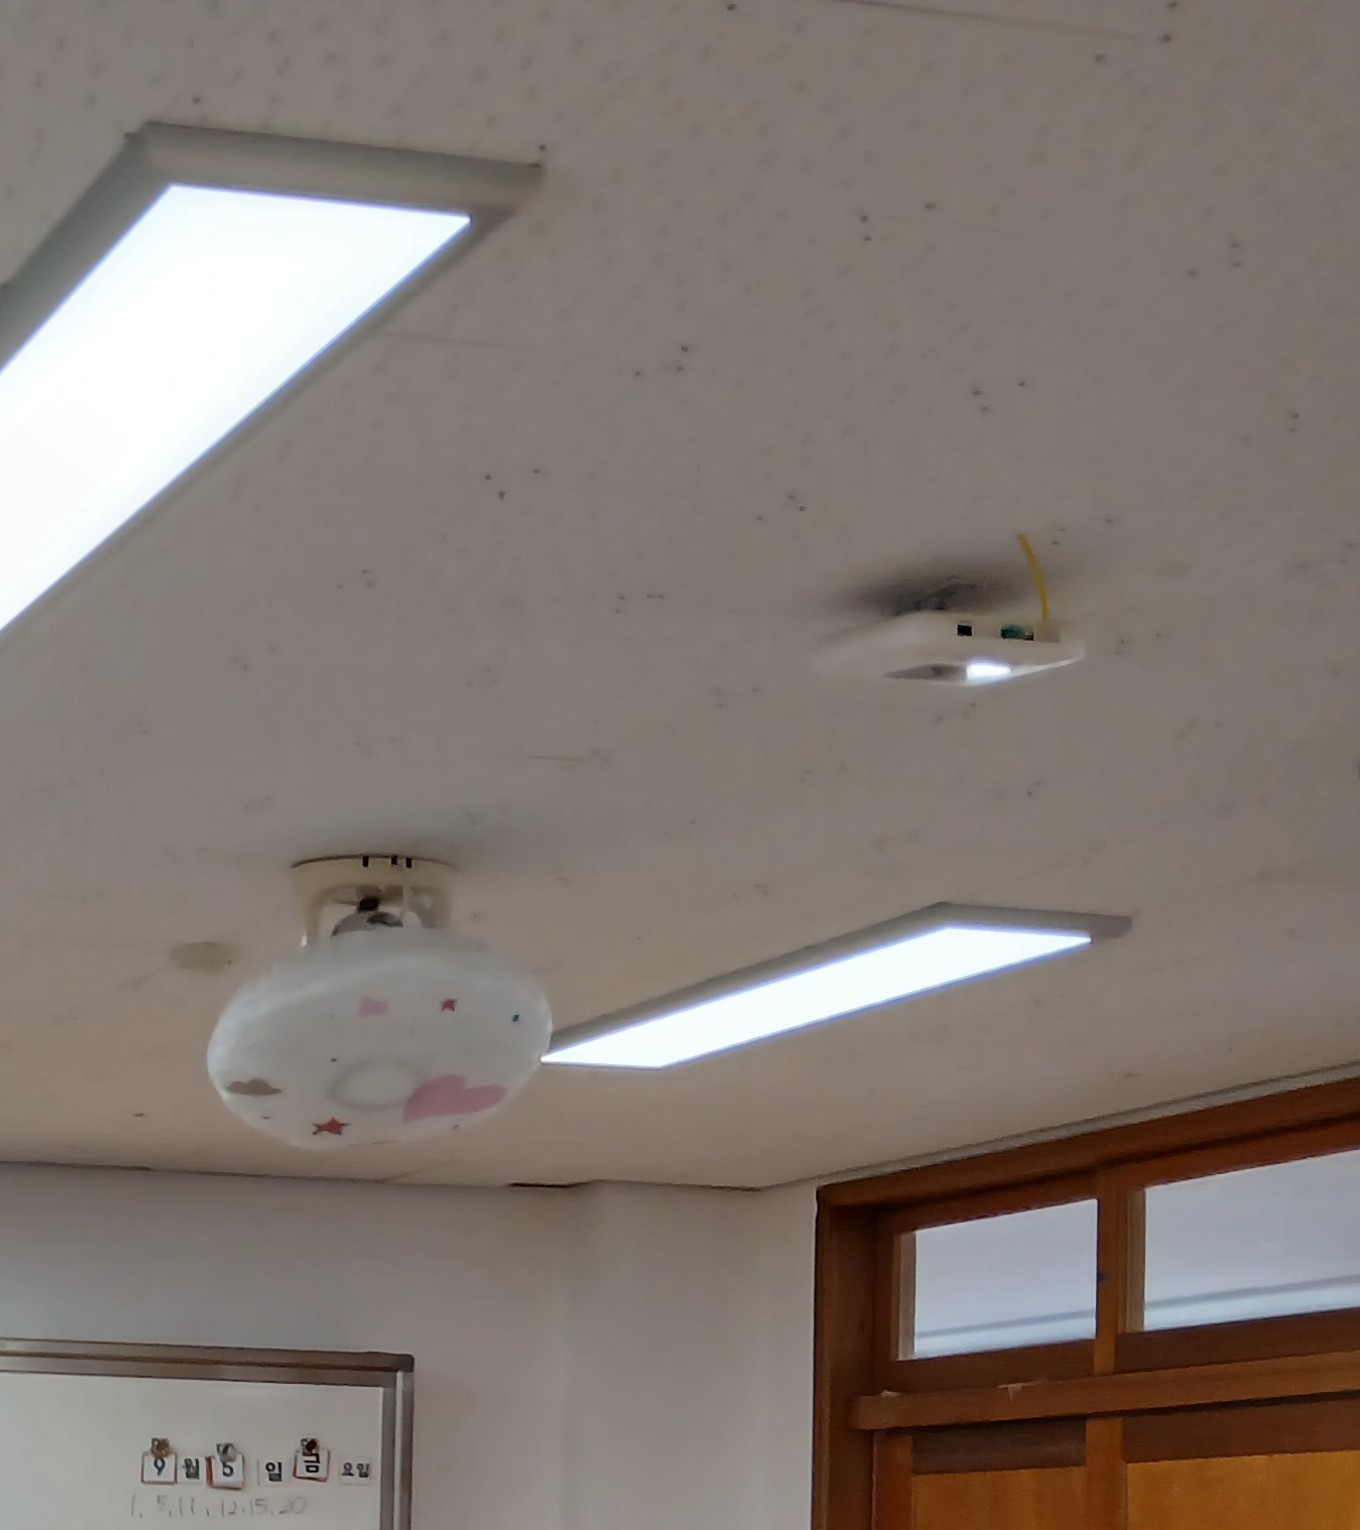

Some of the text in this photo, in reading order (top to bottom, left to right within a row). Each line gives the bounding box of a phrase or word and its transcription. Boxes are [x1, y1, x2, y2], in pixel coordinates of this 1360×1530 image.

[183, 1457, 201, 1480] 월
[265, 1461, 283, 1482] 일
[341, 1462, 371, 1479] 요일
